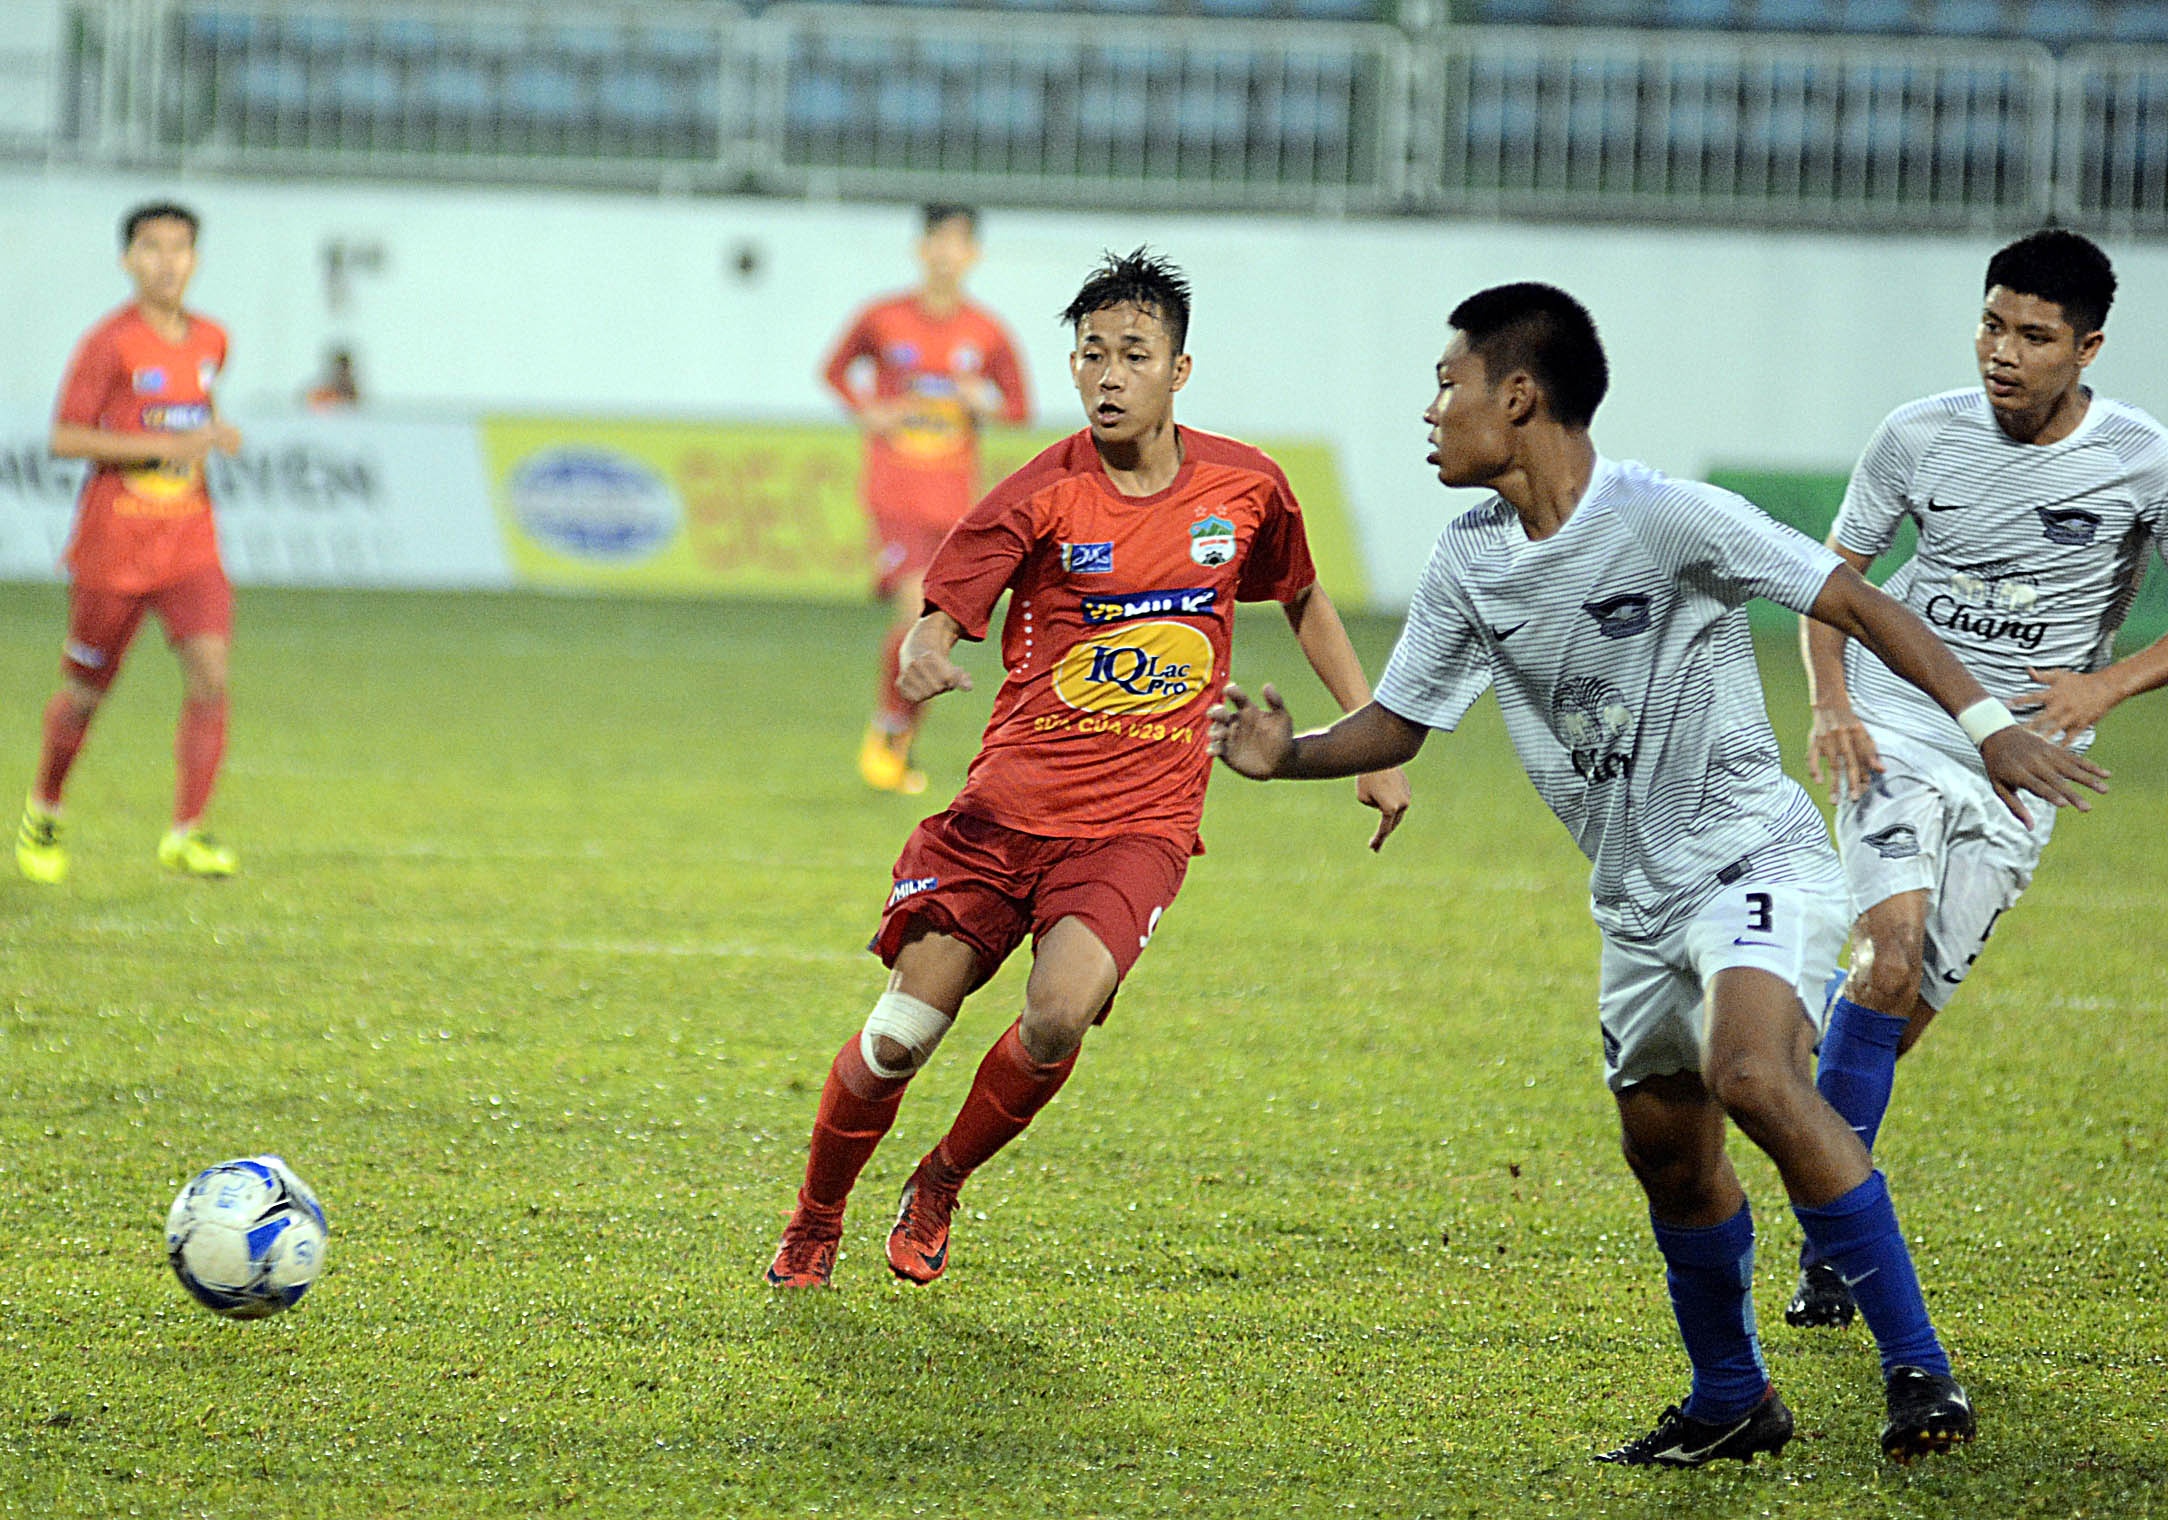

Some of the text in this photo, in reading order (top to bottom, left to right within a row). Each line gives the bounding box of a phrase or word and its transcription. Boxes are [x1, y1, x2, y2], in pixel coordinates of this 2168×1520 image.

[1926, 595, 2048, 649] Chang
[1084, 646, 1190, 695] IQ Lac
[1147, 679, 1187, 695] Pro
[1746, 892, 1773, 933] 3
